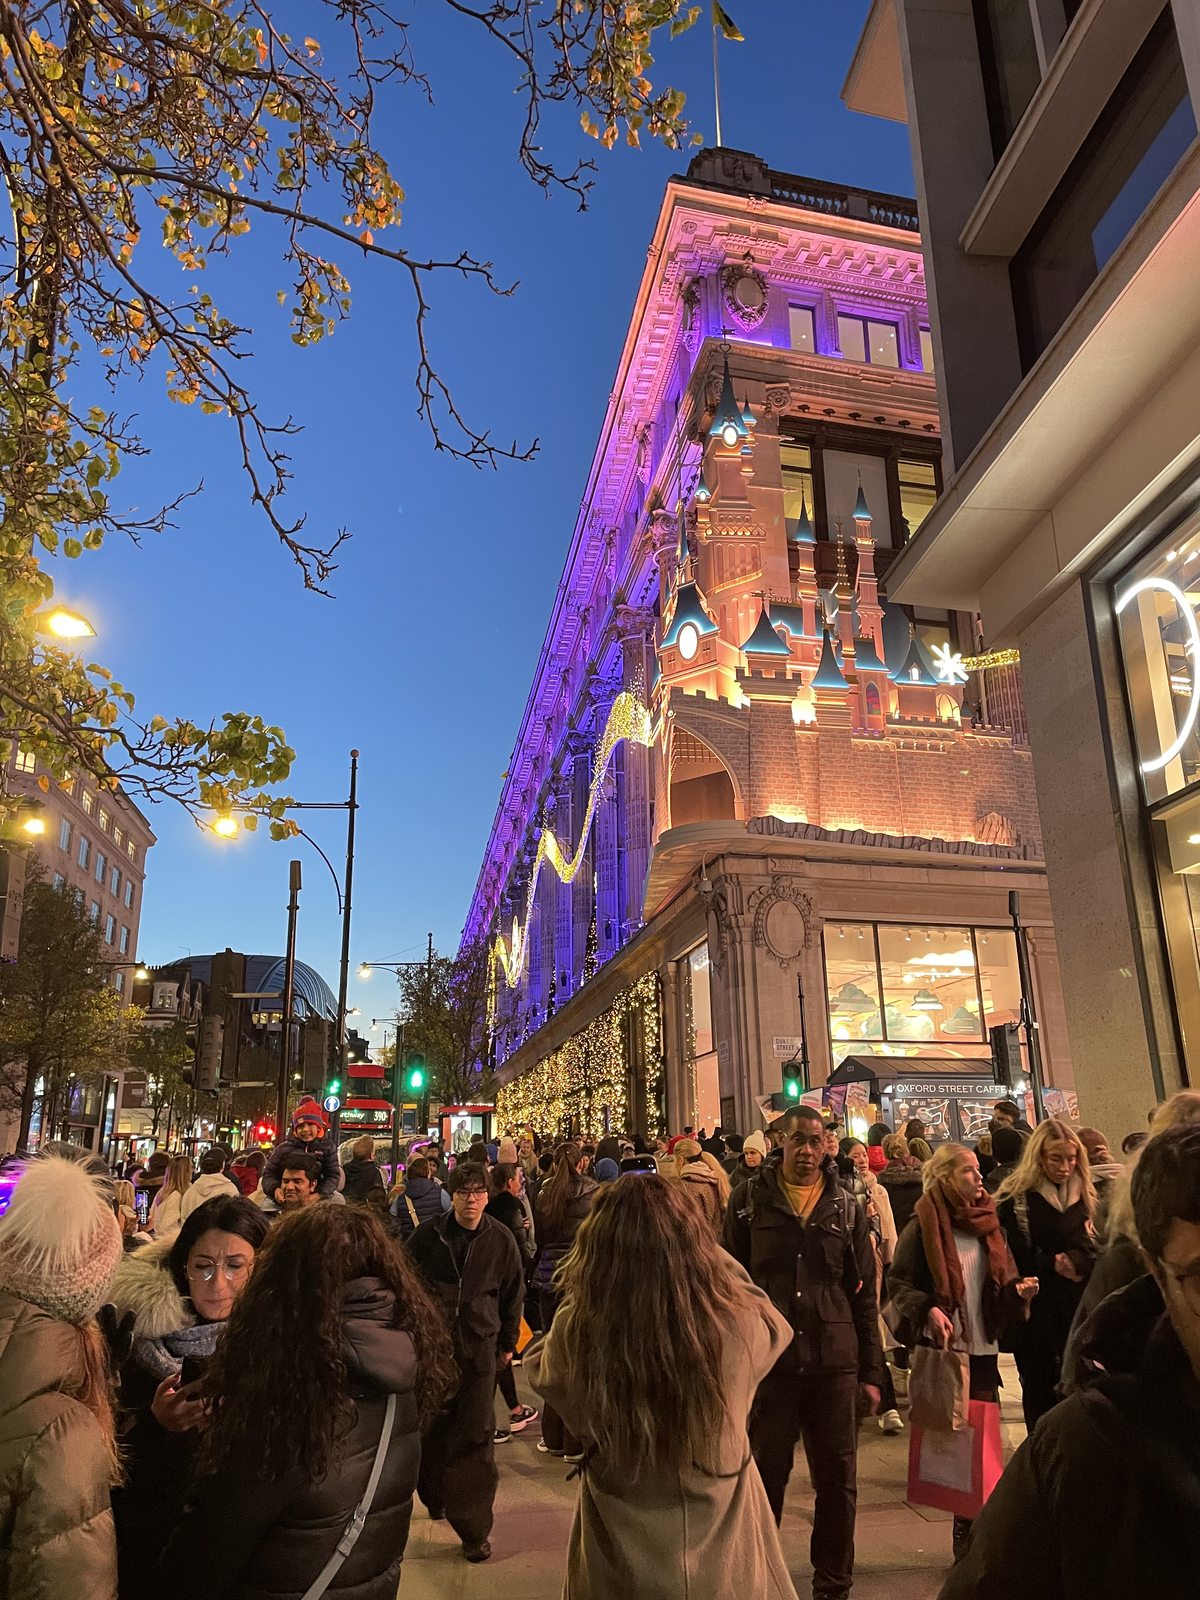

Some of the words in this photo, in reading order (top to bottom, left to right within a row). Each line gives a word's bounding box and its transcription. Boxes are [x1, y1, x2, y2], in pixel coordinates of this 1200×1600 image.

[896, 1084, 937, 1094] OXFORD
[938, 1084, 974, 1094] STREET
[340, 1111, 365, 1120] rchway
